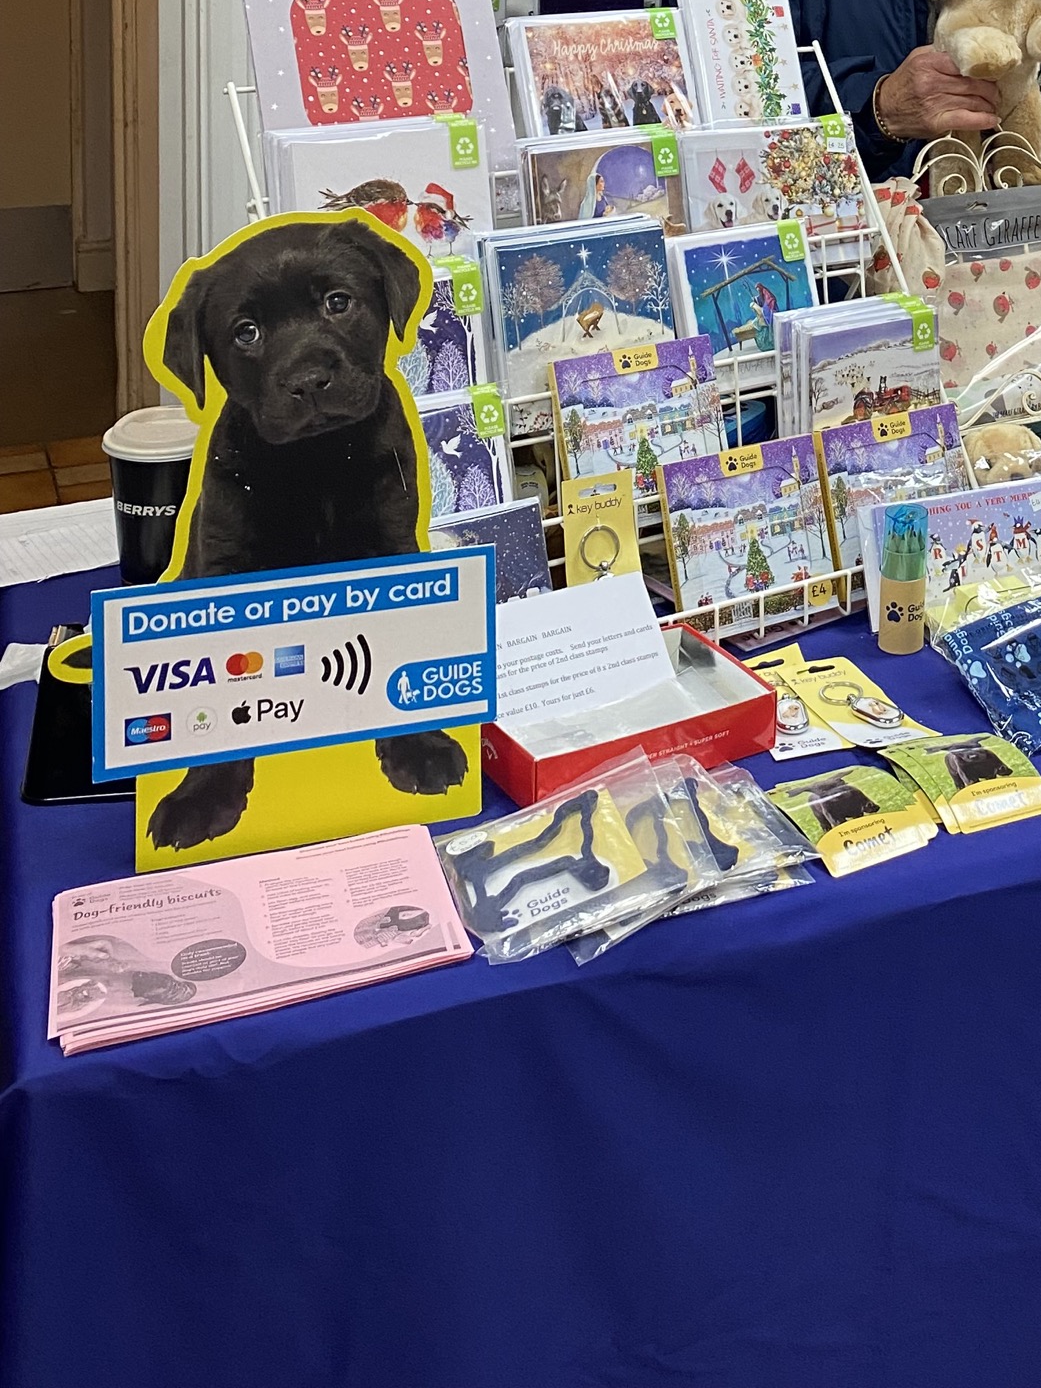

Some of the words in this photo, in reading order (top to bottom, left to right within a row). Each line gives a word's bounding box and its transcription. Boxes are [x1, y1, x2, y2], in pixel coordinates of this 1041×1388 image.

[707, 18, 719, 46] SANTA
[552, 40, 598, 61] Happy
[600, 37, 658, 56] Christmas
[713, 62, 726, 99] WAITING
[983, 214, 1041, 247] GIRAFFE
[633, 352, 652, 360] Guide
[635, 359, 652, 367] Dogs
[889, 420, 906, 428] Guide
[891, 427, 906, 435] Dogs
[739, 454, 757, 462] Guide
[741, 461, 757, 469] Dogs
[116, 500, 177, 516] BERRYS
[576, 501, 593, 514] key
[595, 497, 623, 510] buddy
[811, 583, 827, 597] £4
[128, 602, 236, 635] Donate
[245, 599, 274, 620] or
[282, 592, 338, 622] pay
[346, 585, 382, 611] by
[388, 573, 451, 602] card
[502, 659, 518, 670] your
[520, 653, 544, 666] postage
[569, 642, 587, 651] Send
[586, 638, 602, 649] your
[602, 632, 623, 644] letters
[623, 629, 636, 637] and
[636, 624, 653, 634] cards
[506, 634, 538, 648] BARGAIN
[541, 625, 573, 639] BARGAIN
[422, 660, 483, 684] GUIDE
[507, 669, 518, 677] for
[518, 666, 530, 674] the
[530, 661, 547, 672] price
[547, 658, 556, 666] of
[556, 654, 569, 664] 2nd
[569, 651, 585, 661] class
[585, 644, 609, 657] stamps
[123, 657, 217, 695] VISA
[227, 673, 263, 683] mastercard
[508, 686, 525, 696] class
[525, 680, 549, 692] stamps
[550, 677, 560, 685] for
[560, 673, 572, 682] the
[572, 670, 589, 681] price
[589, 666, 597, 674] of
[608, 661, 621, 670] 2nd
[621, 656, 636, 666] class
[636, 650, 659, 663] stamps
[422, 679, 483, 702] DOGS
[131, 723, 166, 737] Maestro
[192, 720, 212, 732] pay
[257, 698, 305, 723] Pay
[658, 742, 688, 756] STRAIGHT
[693, 735, 713, 746] SUPER
[714, 730, 730, 739] SOFT
[797, 737, 827, 745] Guide
[800, 741, 826, 750] Dogs
[982, 781, 1018, 794] sponsoring
[838, 830, 850, 838] I'm
[850, 818, 886, 834] sponsoring
[843, 826, 894, 856] Comet
[73, 897, 164, 921] Dog-friendly
[167, 887, 222, 906] biscuits
[526, 885, 571, 910] Guide
[530, 896, 568, 918] Dogs
